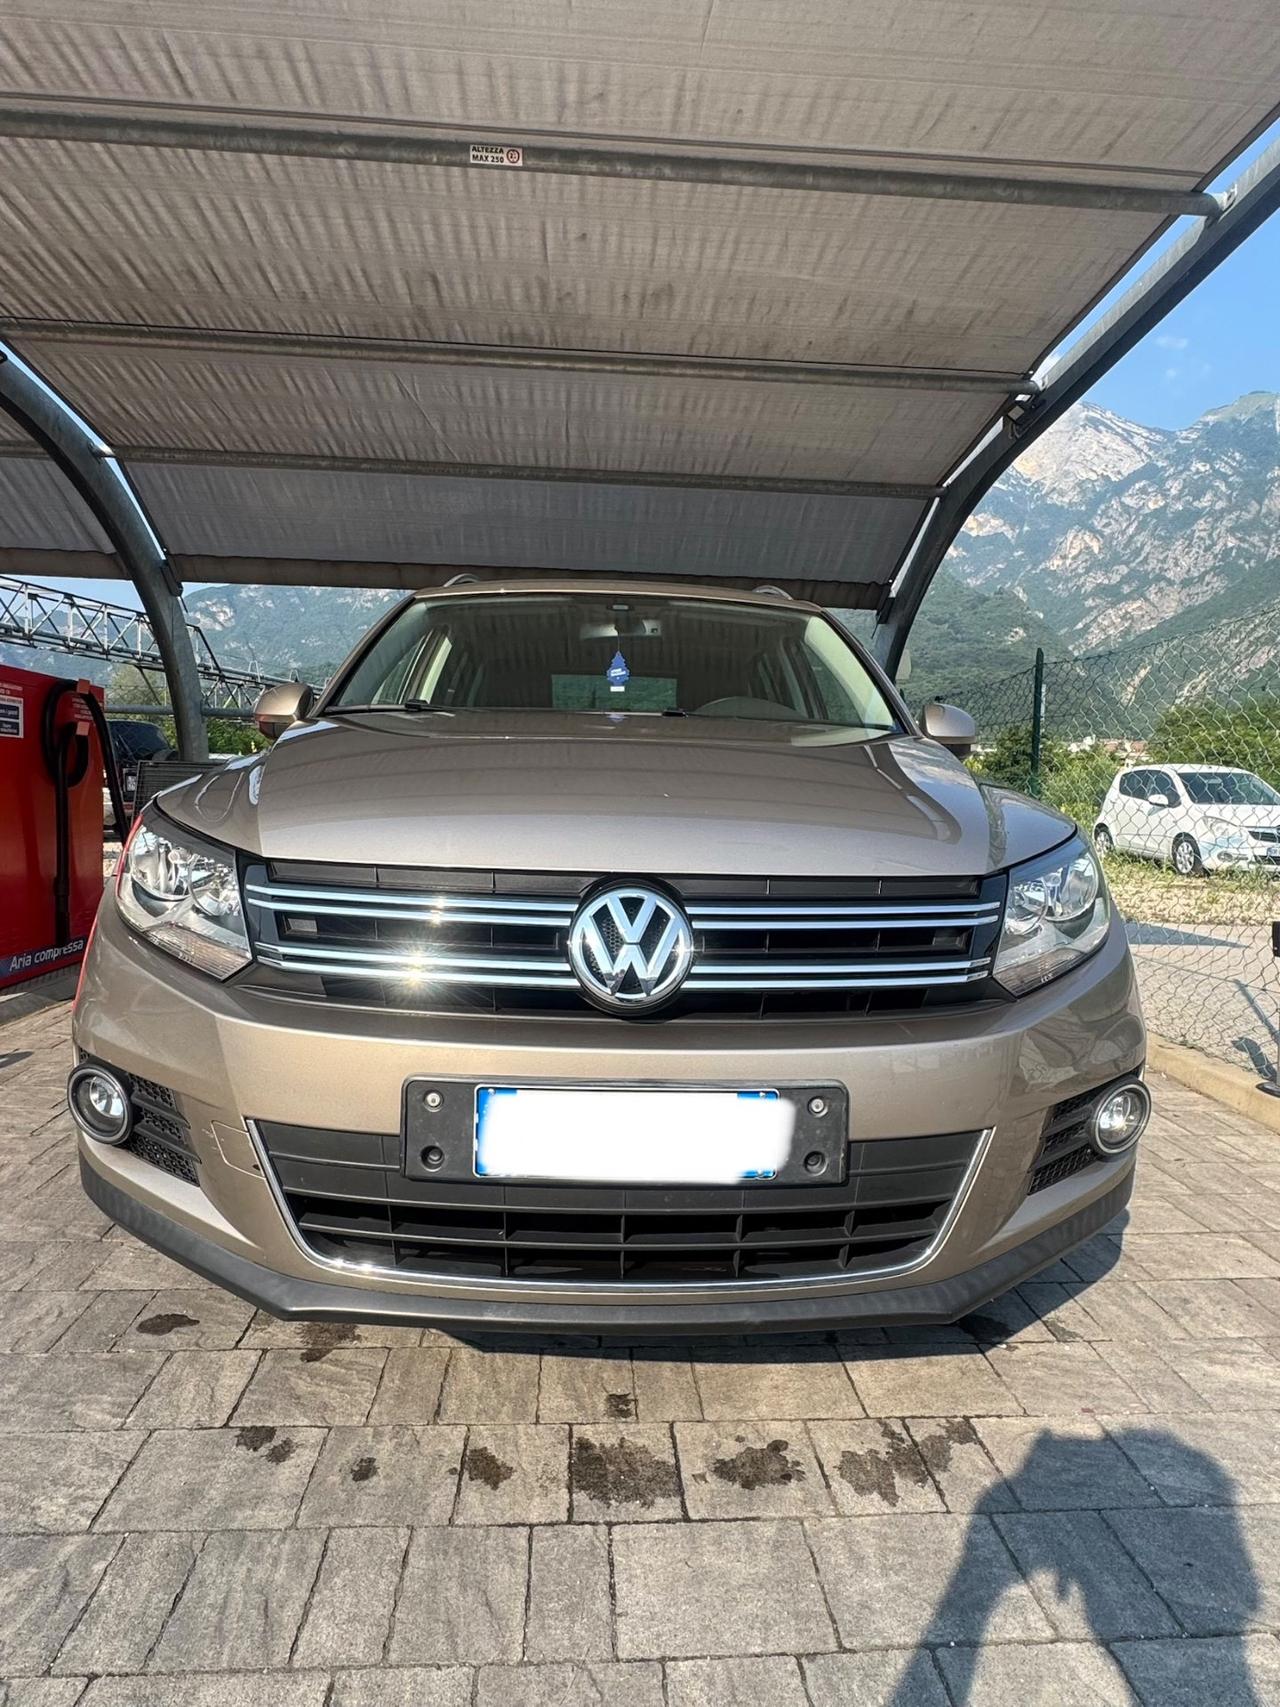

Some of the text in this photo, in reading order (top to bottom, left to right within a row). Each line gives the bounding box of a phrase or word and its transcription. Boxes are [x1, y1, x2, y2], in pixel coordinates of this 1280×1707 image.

[472, 145, 504, 154] ALTEZZA
[472, 154, 489, 162] MAX
[490, 155, 505, 163] 250
[577, 889, 686, 999] VW
[9, 940, 84, 972] Aria compressa
